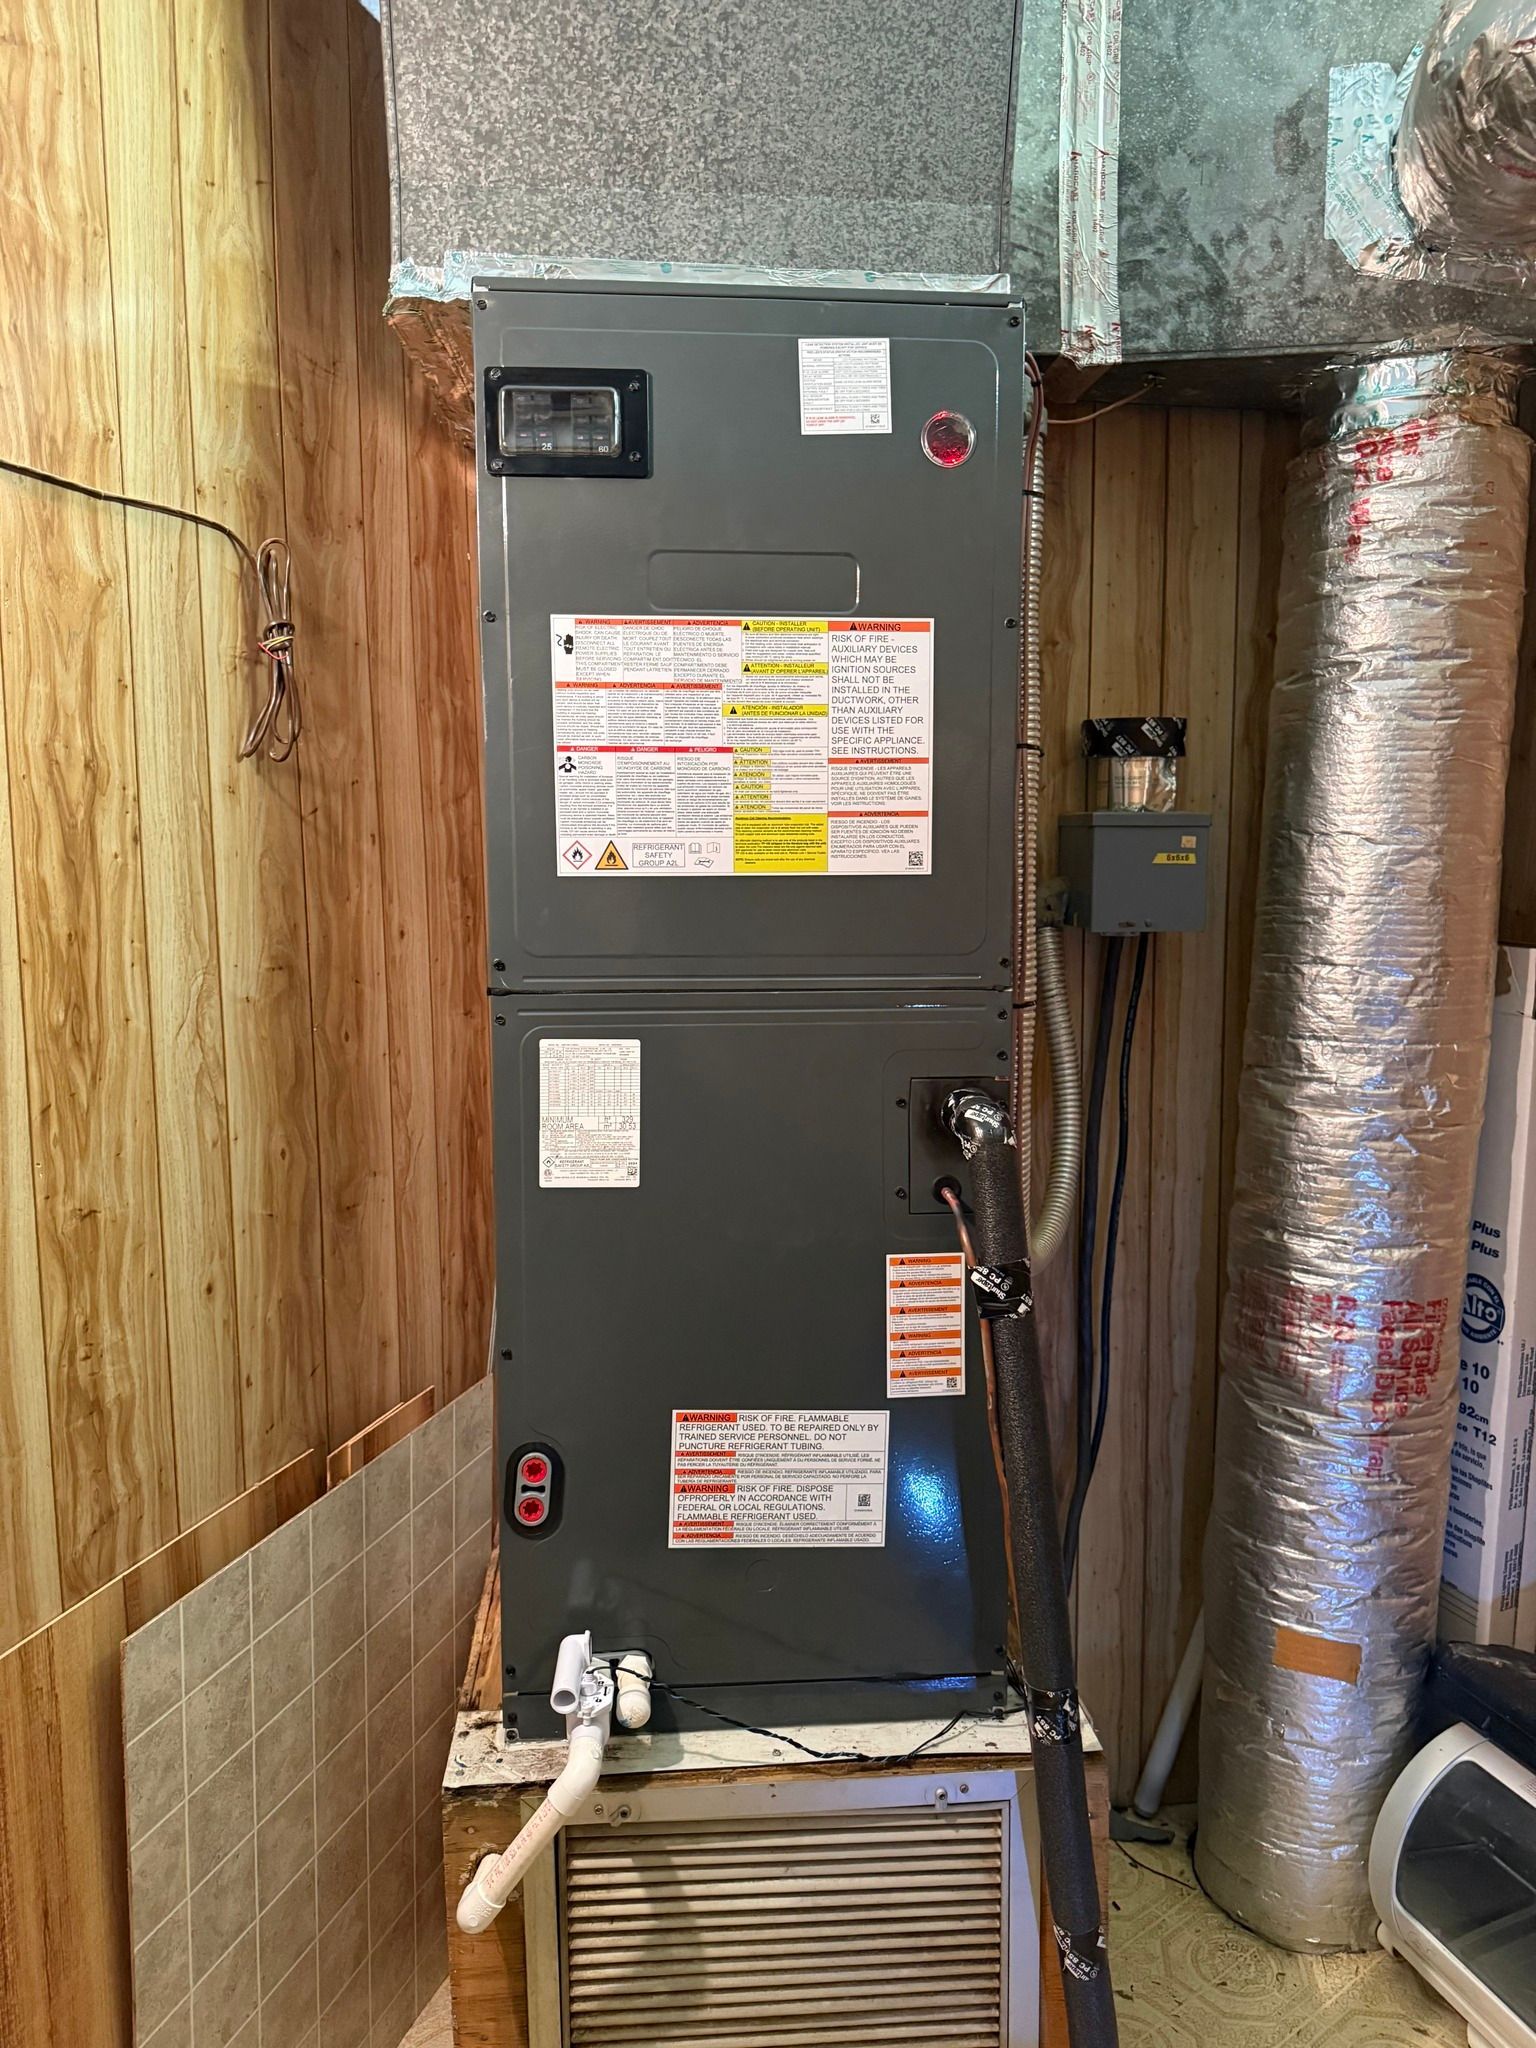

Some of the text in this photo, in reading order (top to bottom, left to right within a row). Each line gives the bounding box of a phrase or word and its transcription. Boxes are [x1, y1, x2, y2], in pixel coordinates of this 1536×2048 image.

[542, 443, 552, 451] 25
[857, 623, 901, 632] WARNING
[832, 634, 852, 642] RISK
[854, 634, 866, 642] OF
[869, 635, 888, 643] FIRE
[832, 645, 918, 653] AUXILIARY DEVICES
[832, 655, 862, 663] WHICH
[885, 655, 896, 663] BE
[832, 665, 916, 674] IGNITION SOURCES
[832, 676, 894, 684] SHALL NOT BE
[832, 686, 910, 694] INSTALLED IN THE
[832, 696, 919, 704] DUCTWORK, OTHER
[832, 706, 903, 714] THAN AUXILIARY
[831, 716, 924, 724] DEVICES LISTED FOR
[831, 726, 894, 734] USE WITH THE
[831, 736, 872, 744] SPECIFIC
[831, 746, 848, 755] SEE
[638, 860, 678, 868] GROUP A2L
[1472, 1220, 1501, 1239] Plus
[1471, 1240, 1500, 1259] Plus
[1472, 1362, 1490, 1379] 10
[1462, 1377, 1479, 1394] 10
[688, 1413, 730, 1422] WARNING
[761, 1414, 772, 1422] OF
[784, 1424, 796, 1432] BE
[842, 1424, 866, 1432] ONLY
[867, 1424, 879, 1432] BY
[814, 1433, 827, 1441] DO
[829, 1433, 846, 1441] NOT
[1473, 1426, 1496, 1446] T12
[679, 1442, 726, 1450] PUNCTURE
[728, 1442, 787, 1450] REFRIGERANT
[686, 1484, 729, 1493] WARNING
[737, 1484, 757, 1492] RISK
[759, 1484, 770, 1492] OF
[796, 1484, 834, 1492] DISPOSE
[678, 1494, 735, 1502] OFPROPERLY
[738, 1494, 746, 1502] IN
[748, 1494, 808, 1502] ACCORDANCE
[730, 1512, 790, 1521] REFRIGERANT
